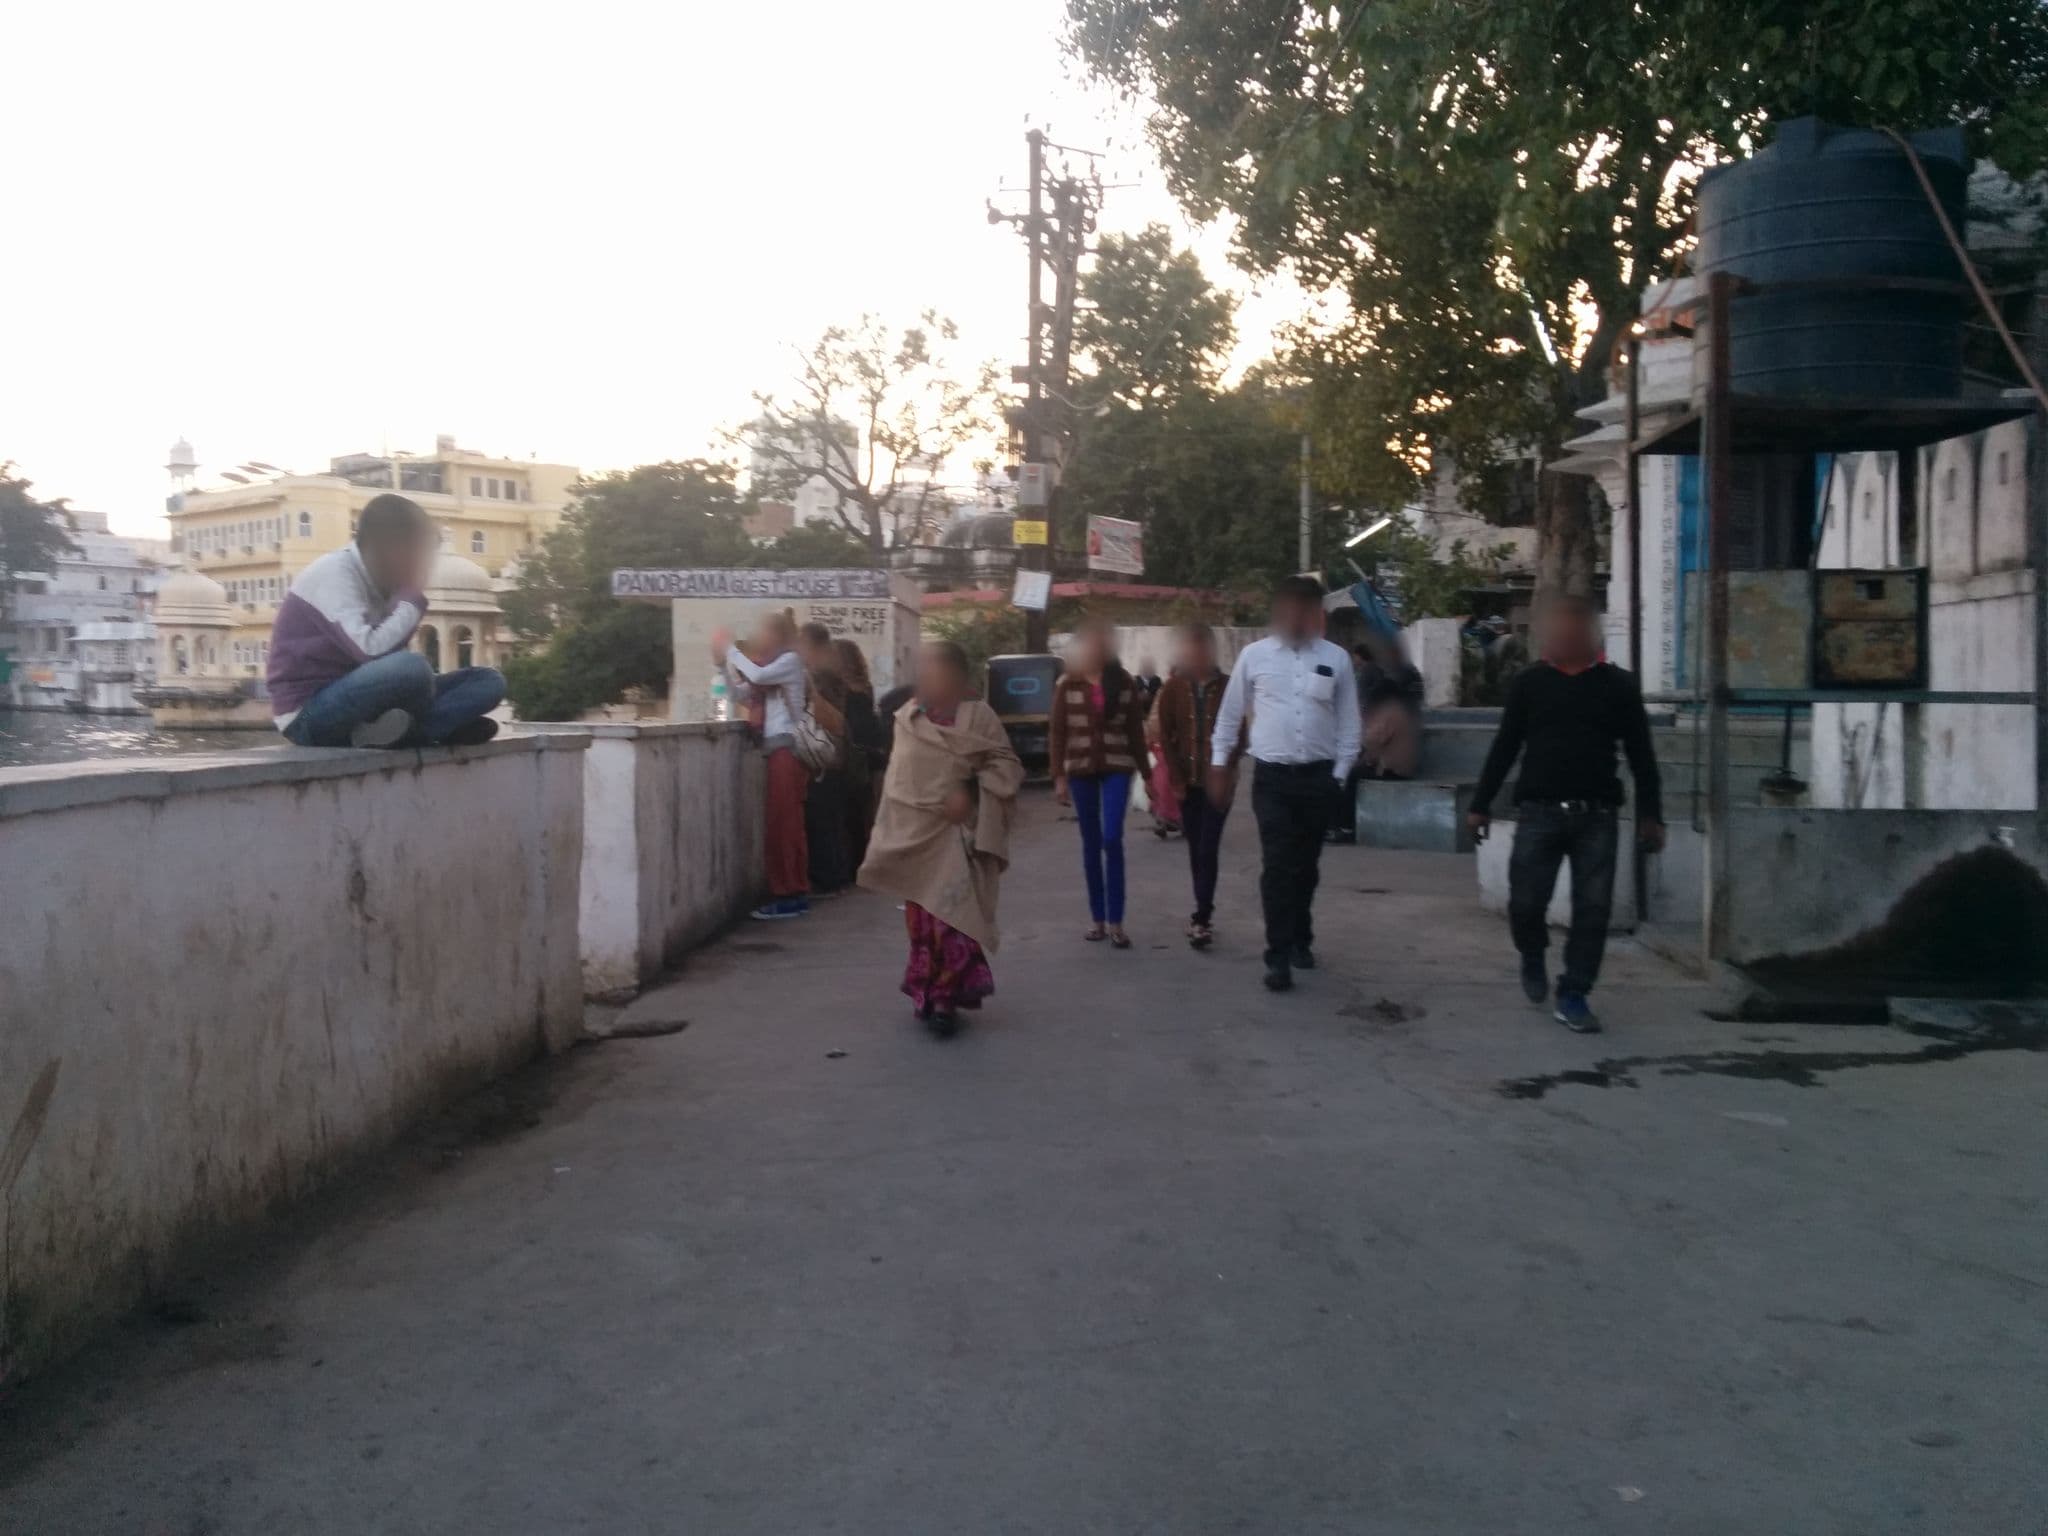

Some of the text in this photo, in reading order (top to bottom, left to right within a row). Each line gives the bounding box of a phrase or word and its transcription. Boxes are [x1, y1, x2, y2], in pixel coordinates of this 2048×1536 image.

[616, 573, 728, 593] PANORAMA
[732, 577, 779, 594] GUEST
[786, 576, 837, 595] HOUSE
[852, 606, 887, 620] FREE
